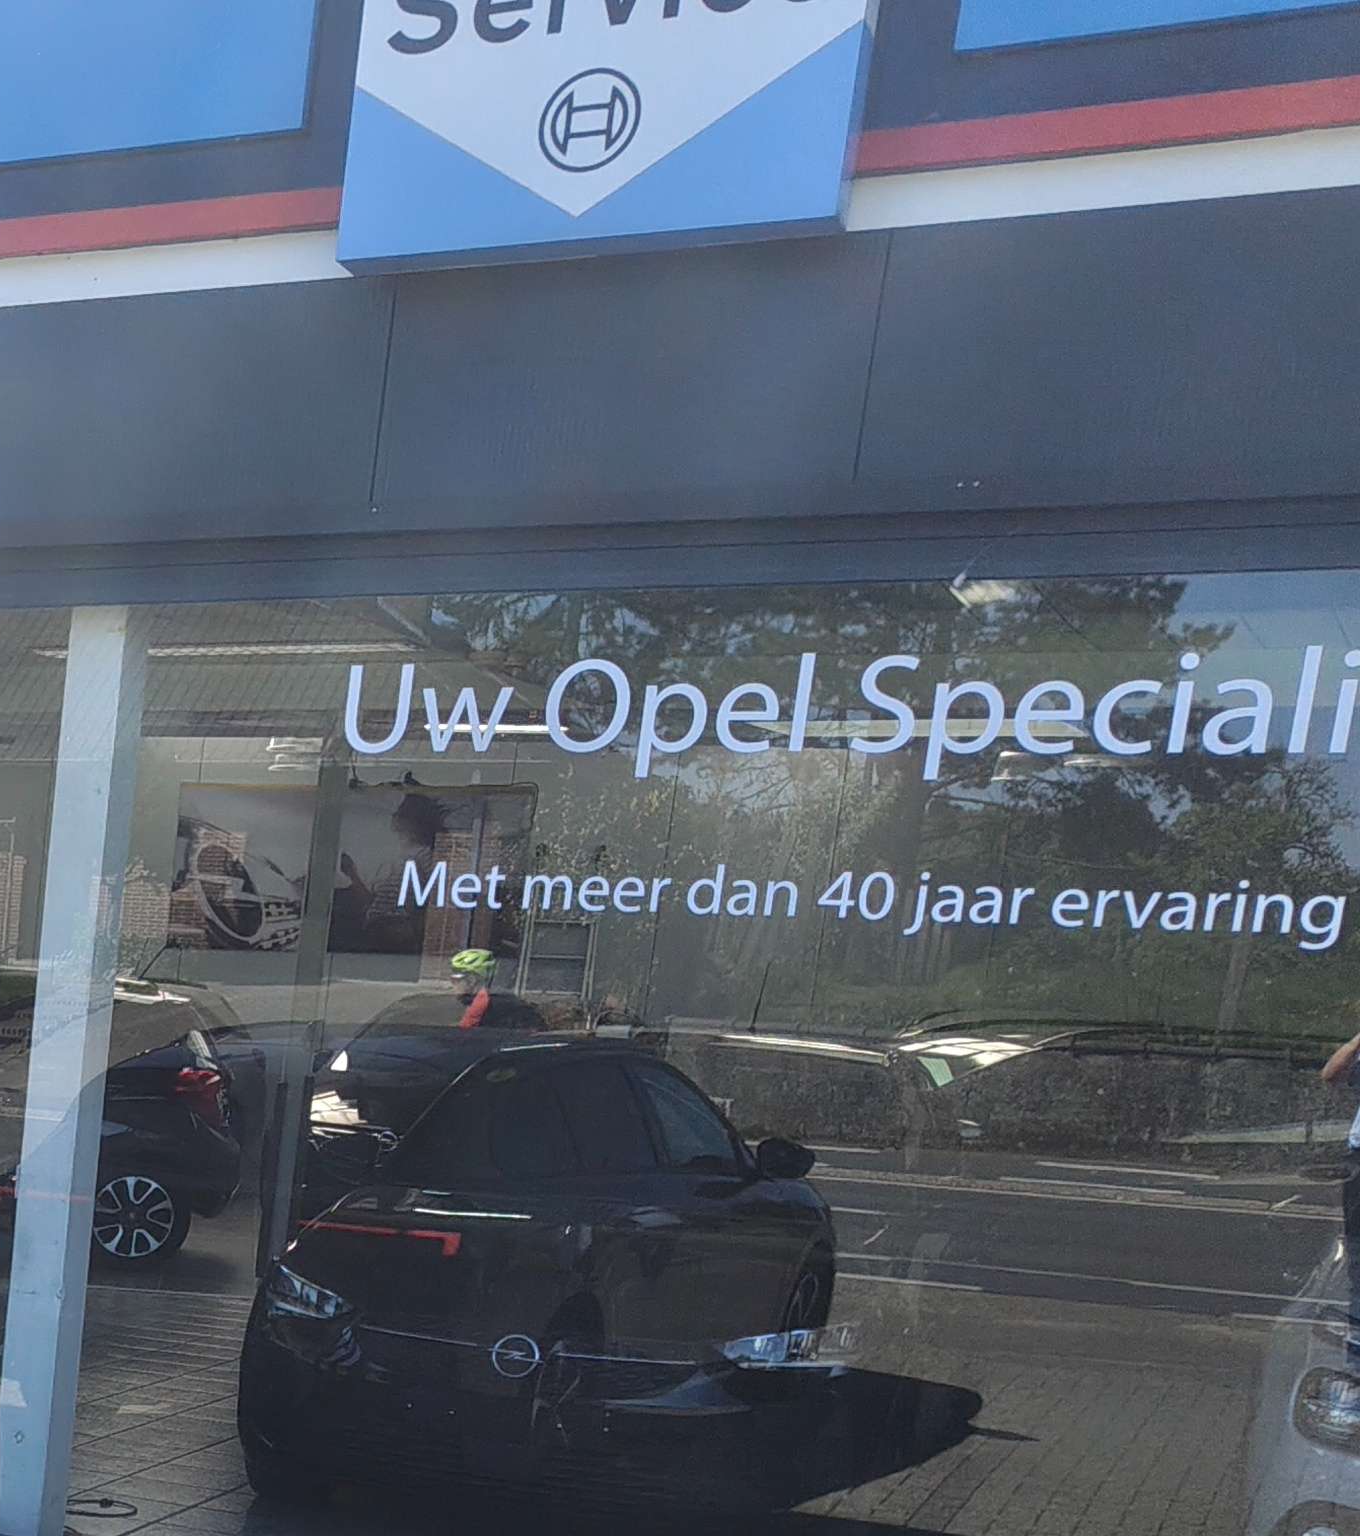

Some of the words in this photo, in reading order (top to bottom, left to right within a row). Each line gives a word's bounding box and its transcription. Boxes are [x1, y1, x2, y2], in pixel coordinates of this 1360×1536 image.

[343, 663, 514, 756] Uw
[545, 652, 816, 779] Opel
[396, 860, 509, 912] Met
[523, 874, 672, 915] meer
[686, 863, 799, 918] dan
[817, 870, 896, 921] 40
[903, 872, 1036, 937] jaar
[1050, 877, 1347, 952] ervaring
